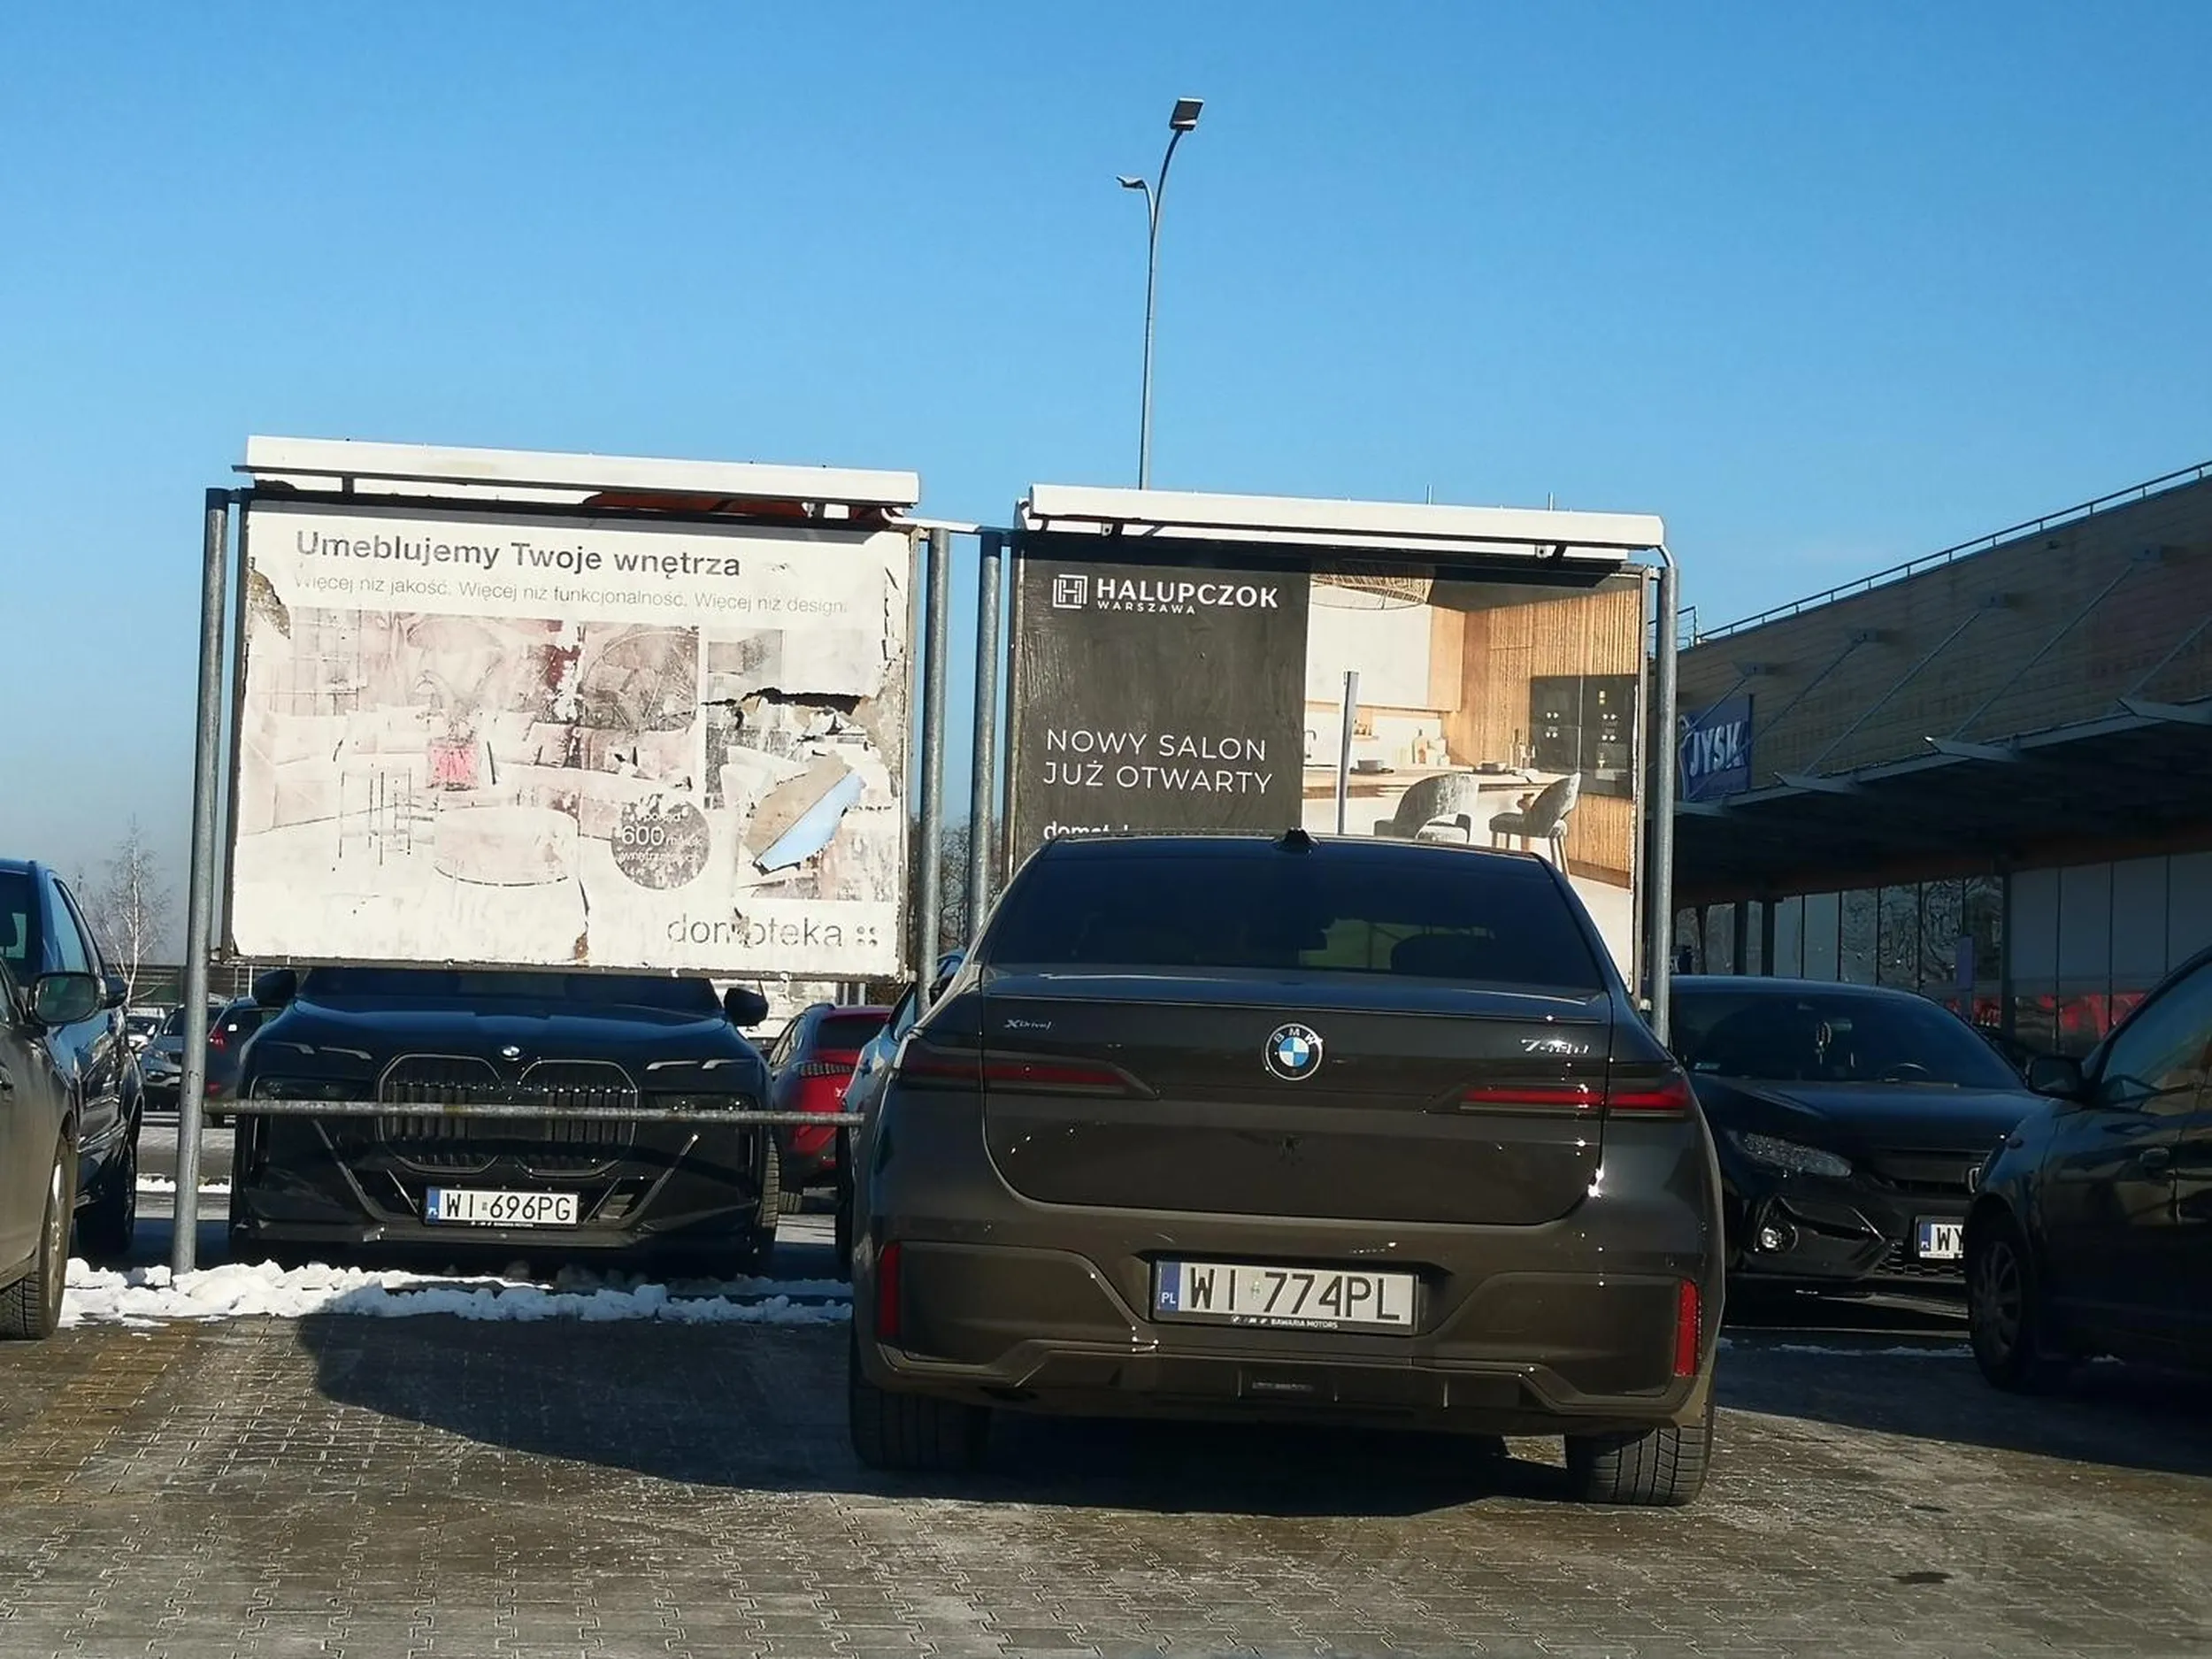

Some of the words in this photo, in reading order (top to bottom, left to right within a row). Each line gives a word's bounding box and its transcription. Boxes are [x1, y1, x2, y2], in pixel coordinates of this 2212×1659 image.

[296, 530, 500, 570] Umeblujemy
[511, 541, 603, 574] Twoje
[614, 552, 741, 580] wnętrza
[458, 580, 518, 602] Więcej
[694, 592, 752, 613] Więcej
[1097, 578, 1279, 609] HALUPCZOK
[1097, 600, 1195, 615] WARSZAWA
[1047, 728, 1148, 754] NOWY
[1158, 734, 1266, 762] SALON
[1689, 720, 1745, 777] JYSK
[1043, 760, 1105, 787] JUŻ
[1116, 765, 1272, 794] OTWARTY
[622, 825, 665, 846] 600
[446, 1193, 474, 1218] WI
[489, 1194, 571, 1222] 696PG
[1161, 1292, 1177, 1304] PL
[1190, 1266, 1236, 1311] WI
[1263, 1271, 1401, 1321] 774PL
[1306, 1319, 1339, 1329] MOTORS
